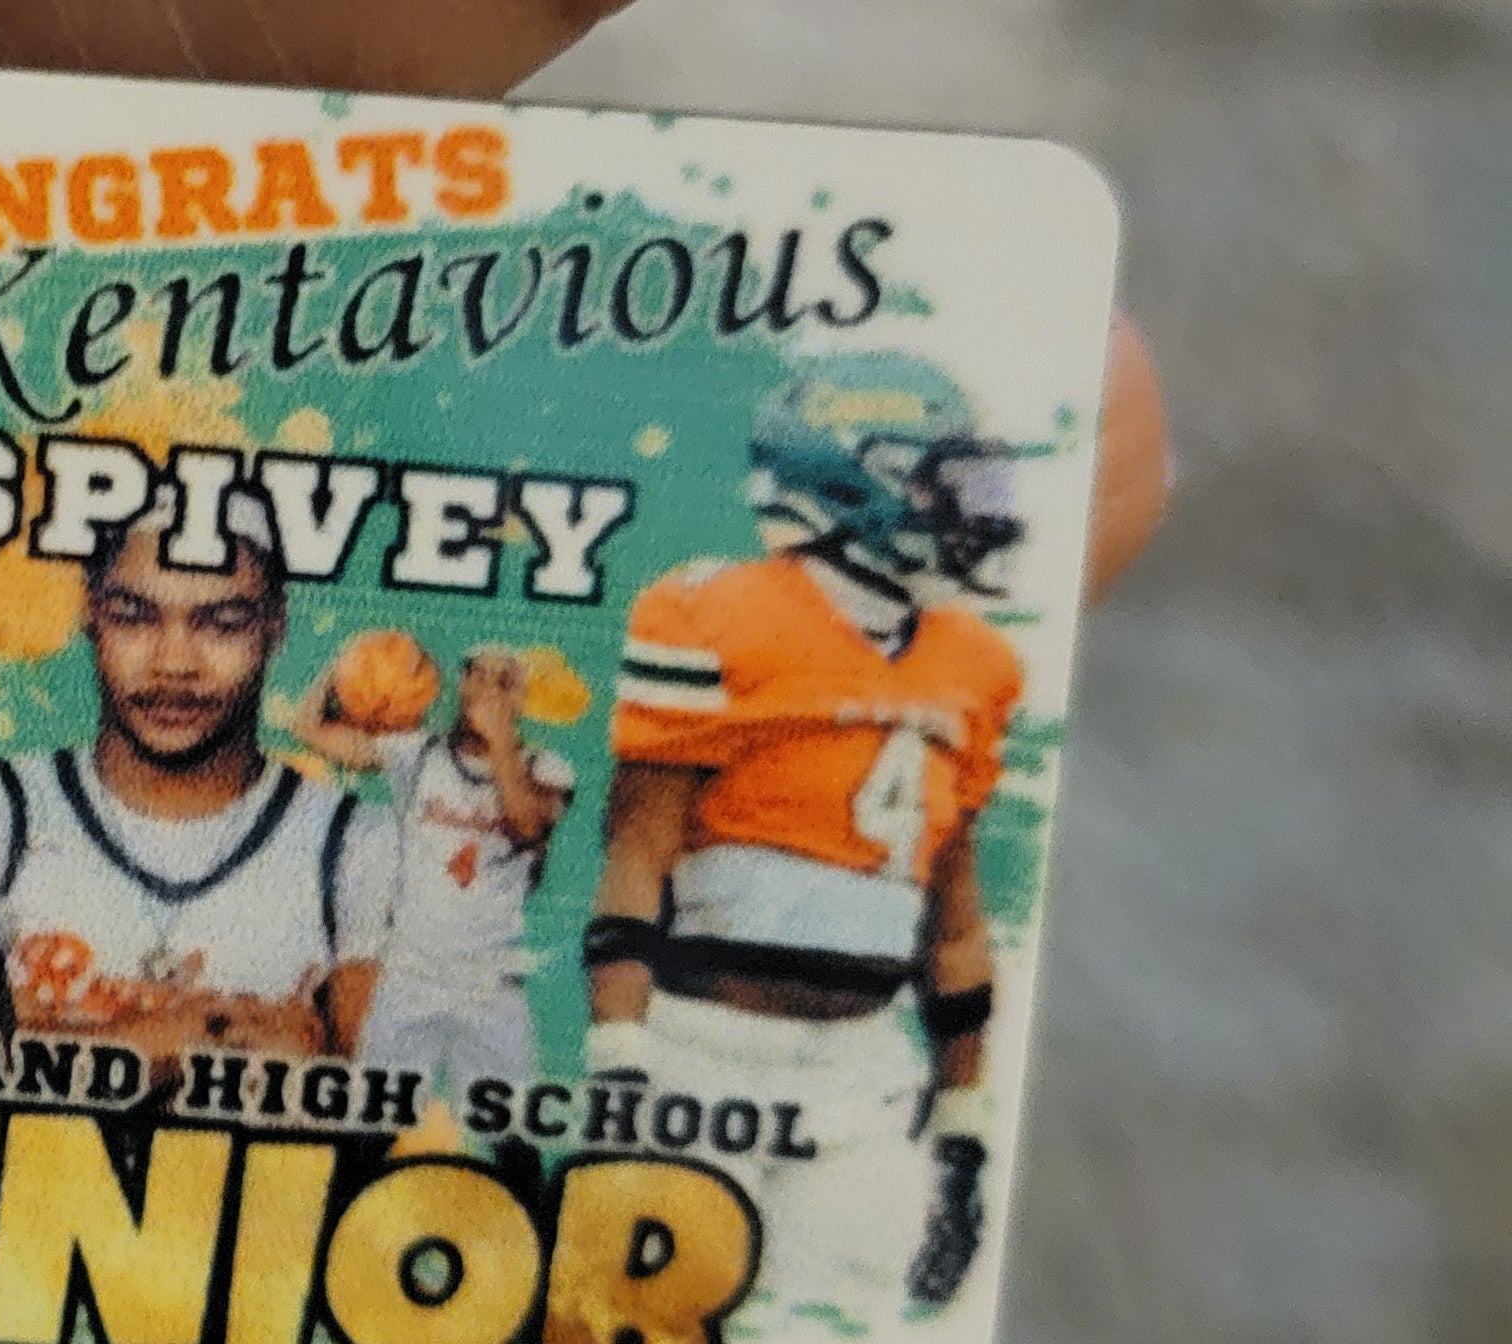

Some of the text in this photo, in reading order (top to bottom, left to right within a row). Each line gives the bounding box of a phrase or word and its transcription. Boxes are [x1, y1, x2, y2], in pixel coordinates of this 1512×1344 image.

[852, 724, 928, 878] 4
[185, 1052, 425, 1128] HIGH
[464, 1074, 819, 1161] SCHOOL
